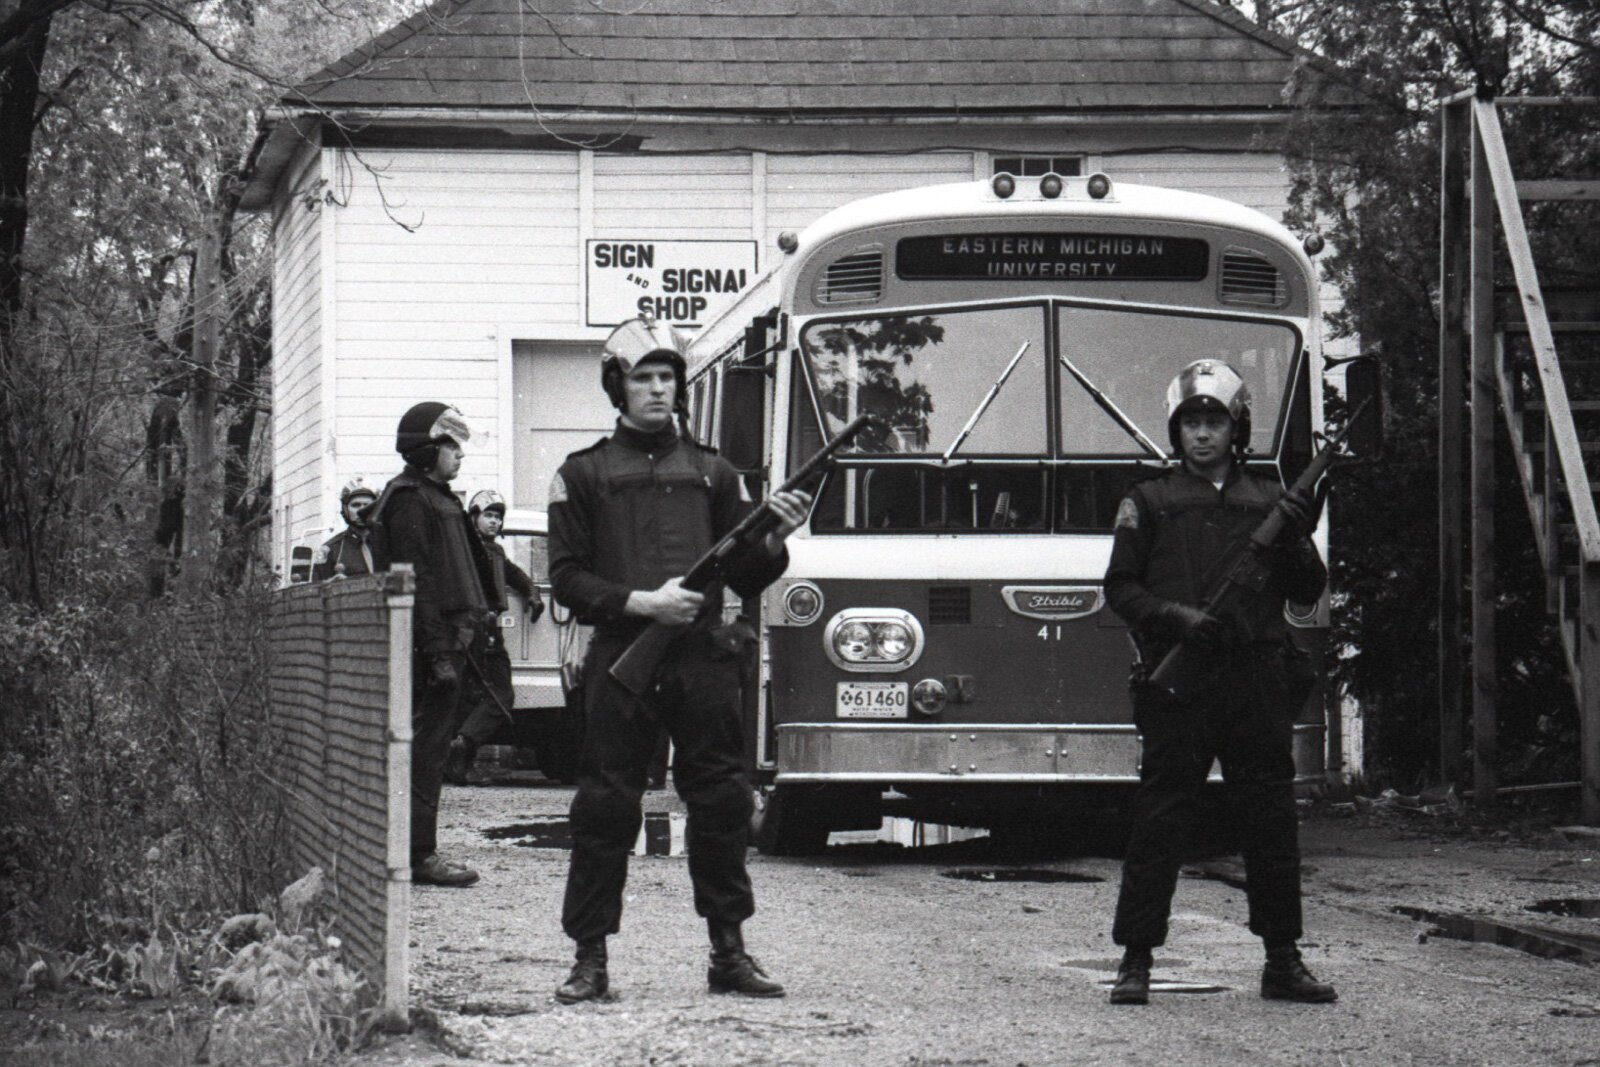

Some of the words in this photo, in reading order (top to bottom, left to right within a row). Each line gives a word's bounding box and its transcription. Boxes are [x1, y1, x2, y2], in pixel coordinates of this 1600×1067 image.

[943, 238, 1045, 254] EASTERN
[1060, 239, 1164, 255] MICHIGAN
[594, 244, 654, 268] SIGN
[987, 262, 1117, 277] UNIVERSITY
[626, 273, 650, 289] AND
[637, 296, 708, 321] SHOP
[1037, 625, 1062, 641] 41
[854, 690, 905, 706] 61460
